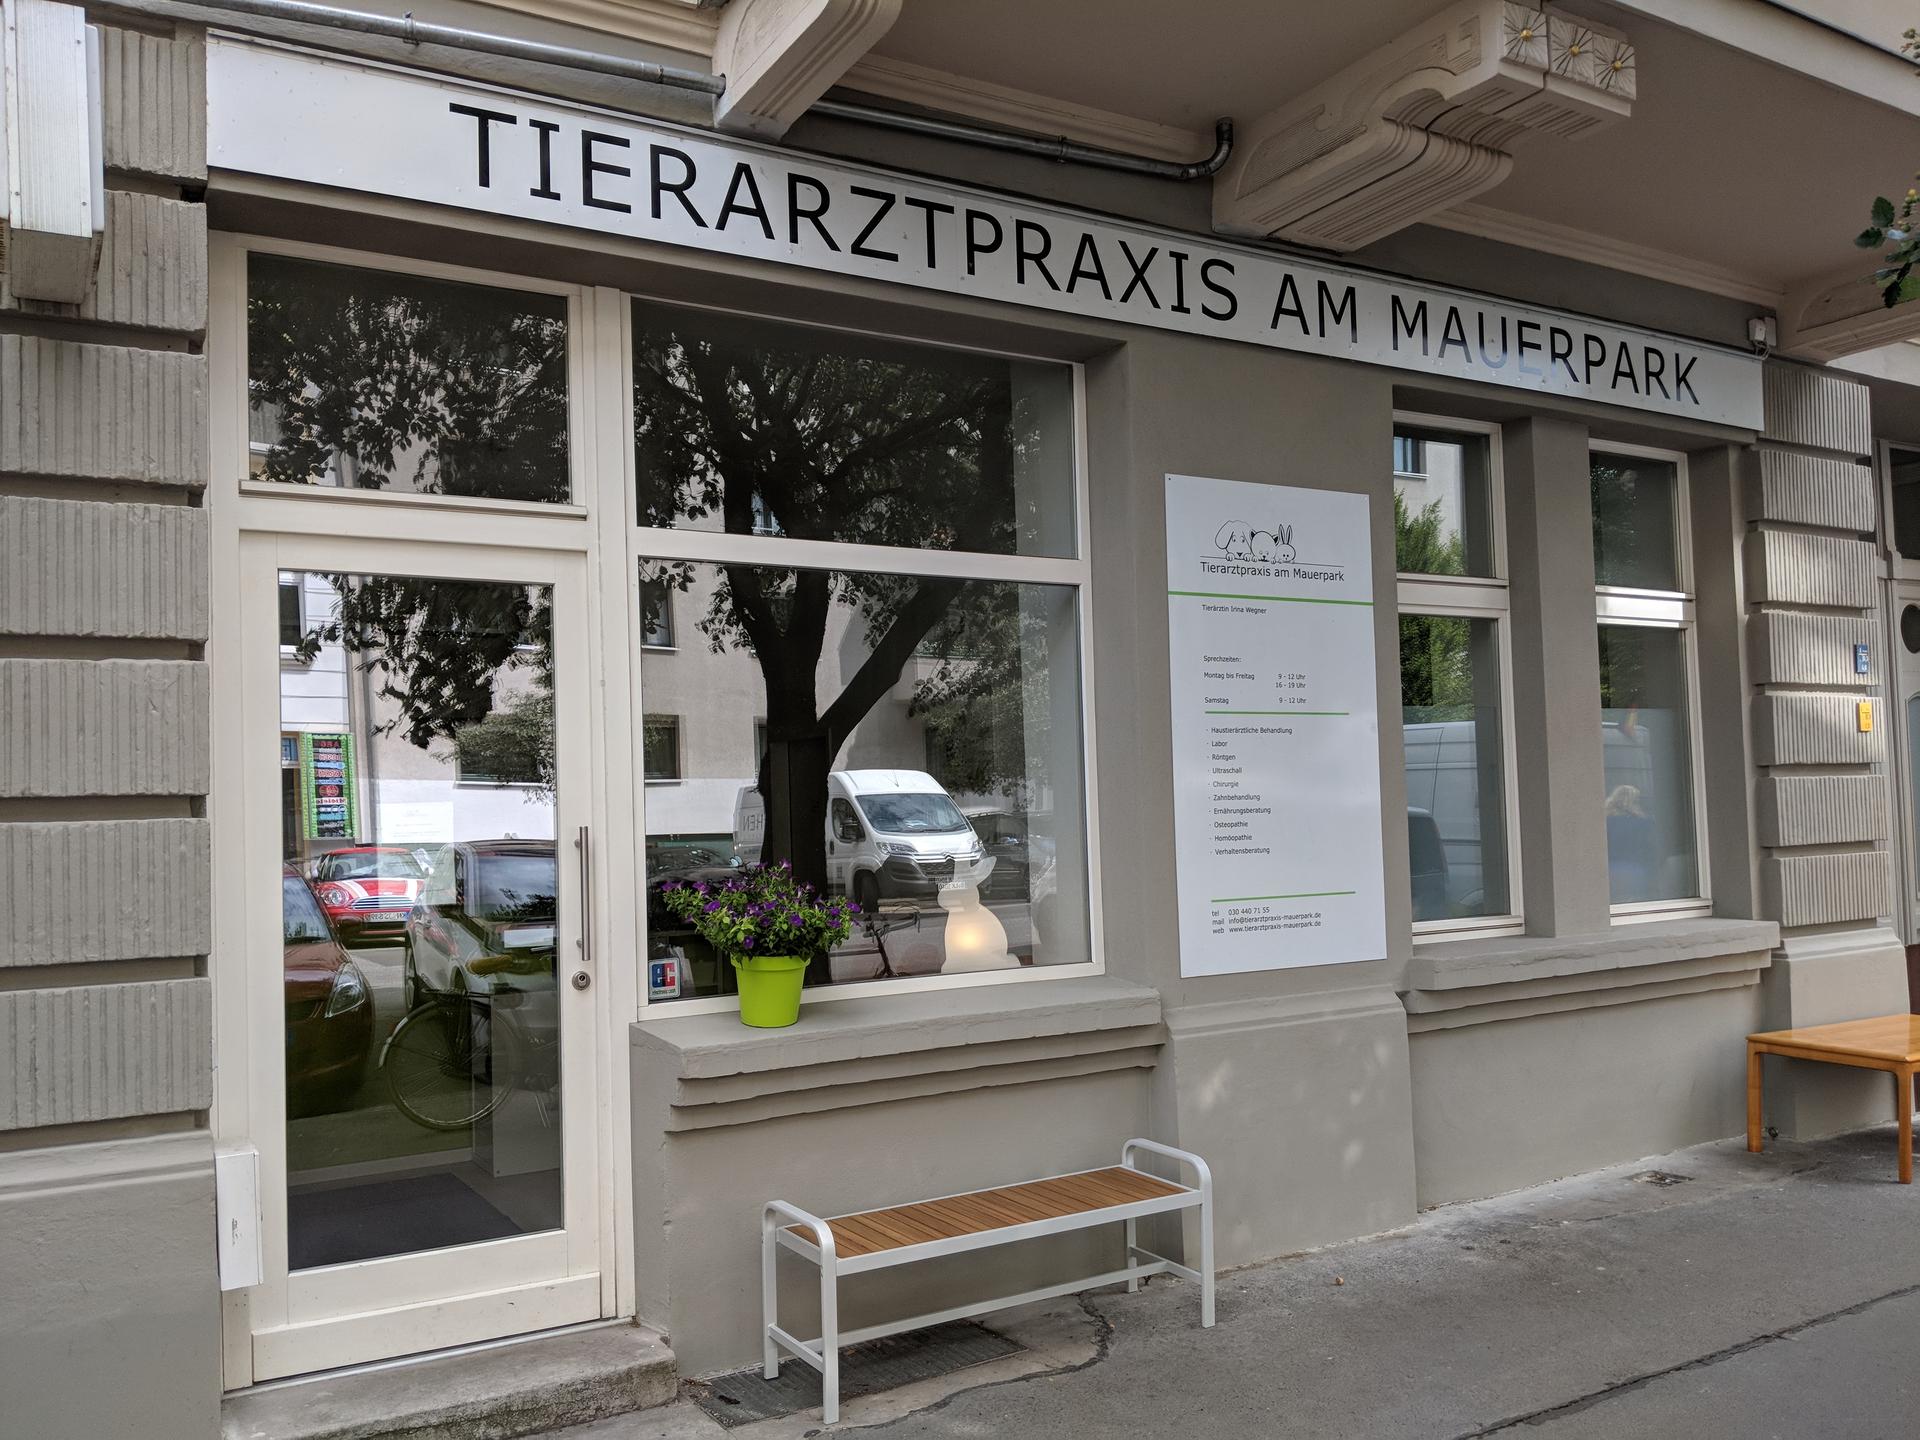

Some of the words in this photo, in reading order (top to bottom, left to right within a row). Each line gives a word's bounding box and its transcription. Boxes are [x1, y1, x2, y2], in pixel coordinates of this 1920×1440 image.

[449, 103, 1239, 321] TIERARZTPRAXIS
[1271, 273, 1359, 344] AM
[1391, 294, 1701, 405] MAUERPARK
[1200, 561, 1271, 578] Tierarztpraxis
[1274, 568, 1290, 578] am
[1293, 568, 1345, 582] Mauerpark
[1202, 604, 1229, 612] Tierärztin
[1231, 605, 1244, 613] Irina
[1246, 606, 1267, 614] Wegner
[1203, 655, 1242, 663] Sprechzeiten:
[1203, 672, 1225, 680] Montag
[1236, 672, 1255, 680] Freitag
[1204, 696, 1229, 704] Samstag
[1260, 727, 1293, 735] Behandlung
[1228, 908, 1239, 916] 030
[1229, 912, 1321, 924] info@tierarztpraxis-mauerpark.de
[1229, 921, 1321, 932] www.tierarztpraxis-mauerpark.de
